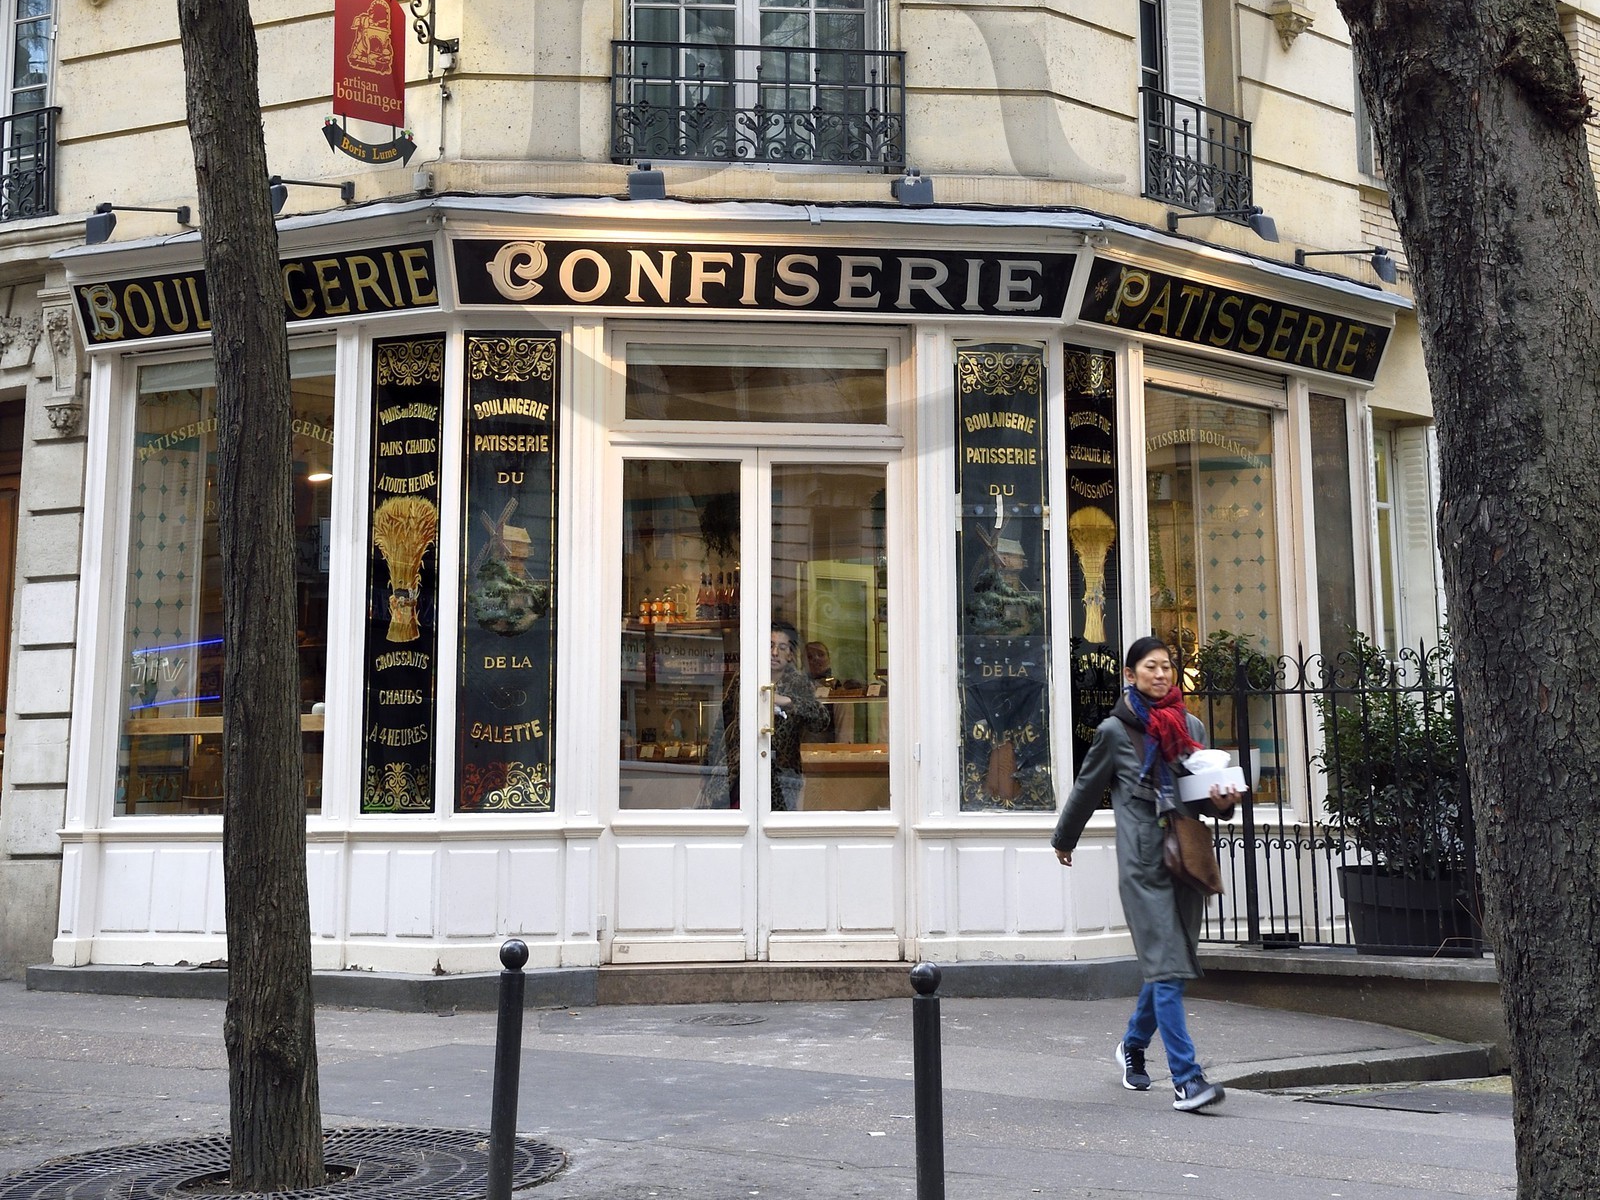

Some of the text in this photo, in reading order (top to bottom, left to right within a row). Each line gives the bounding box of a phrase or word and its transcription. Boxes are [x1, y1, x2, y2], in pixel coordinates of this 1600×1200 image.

[343, 76, 379, 93] artisan
[336, 82, 403, 112] boulanger
[341, 136, 398, 160] Boris Lume
[486, 240, 1044, 313] CONFISERIE
[80, 248, 438, 341] BOULGERIE
[1104, 265, 1366, 374] PATISSERIE
[379, 405, 401, 426] PAINS
[408, 402, 438, 422] BEURRE
[473, 397, 549, 421] BOULANGERIE
[964, 411, 1036, 434] BOULANGERIE
[380, 438, 436, 456] PAINS CHAUDS
[474, 434, 549, 452] PATISSERIE
[1146, 429, 1197, 454] ÂTISSERIE
[966, 447, 1037, 465] PATISSERIE
[1102, 449, 1112, 465] DE
[384, 476, 407, 494] TOUTE
[408, 471, 437, 493] HEURE
[497, 471, 524, 484] DU
[1070, 475, 1114, 499] CROISSANTS
[989, 484, 1014, 496] DU
[375, 650, 430, 672] CROISSANTS
[484, 655, 533, 669] DE LA
[982, 664, 1028, 677] DE LA
[1090, 652, 1116, 675] PORTE
[379, 689, 423, 705] CHAUDS
[1080, 689, 1115, 706] EN VILLE
[379, 727, 387, 745] 4
[387, 723, 428, 747] HEURES
[470, 719, 544, 743] GALETTE
